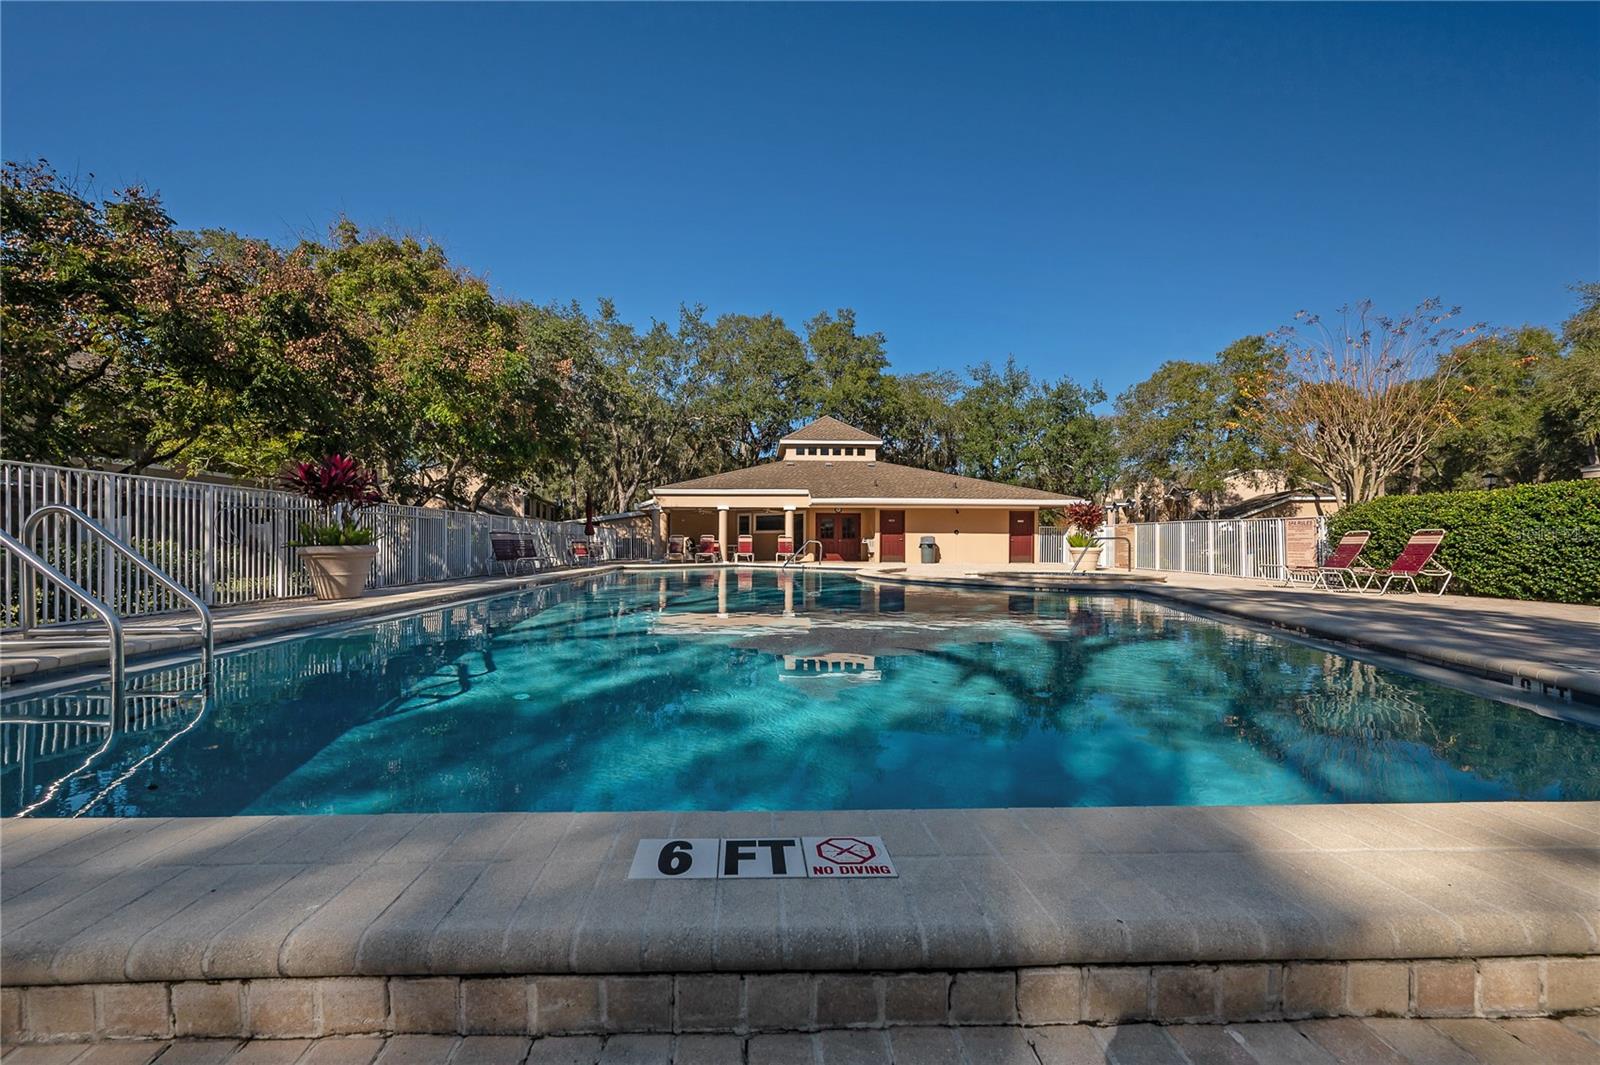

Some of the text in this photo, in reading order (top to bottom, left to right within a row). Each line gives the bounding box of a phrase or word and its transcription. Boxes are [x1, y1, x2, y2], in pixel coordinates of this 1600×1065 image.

[657, 839, 796, 876] 6 FT
[813, 865, 891, 875] NO DIVING
